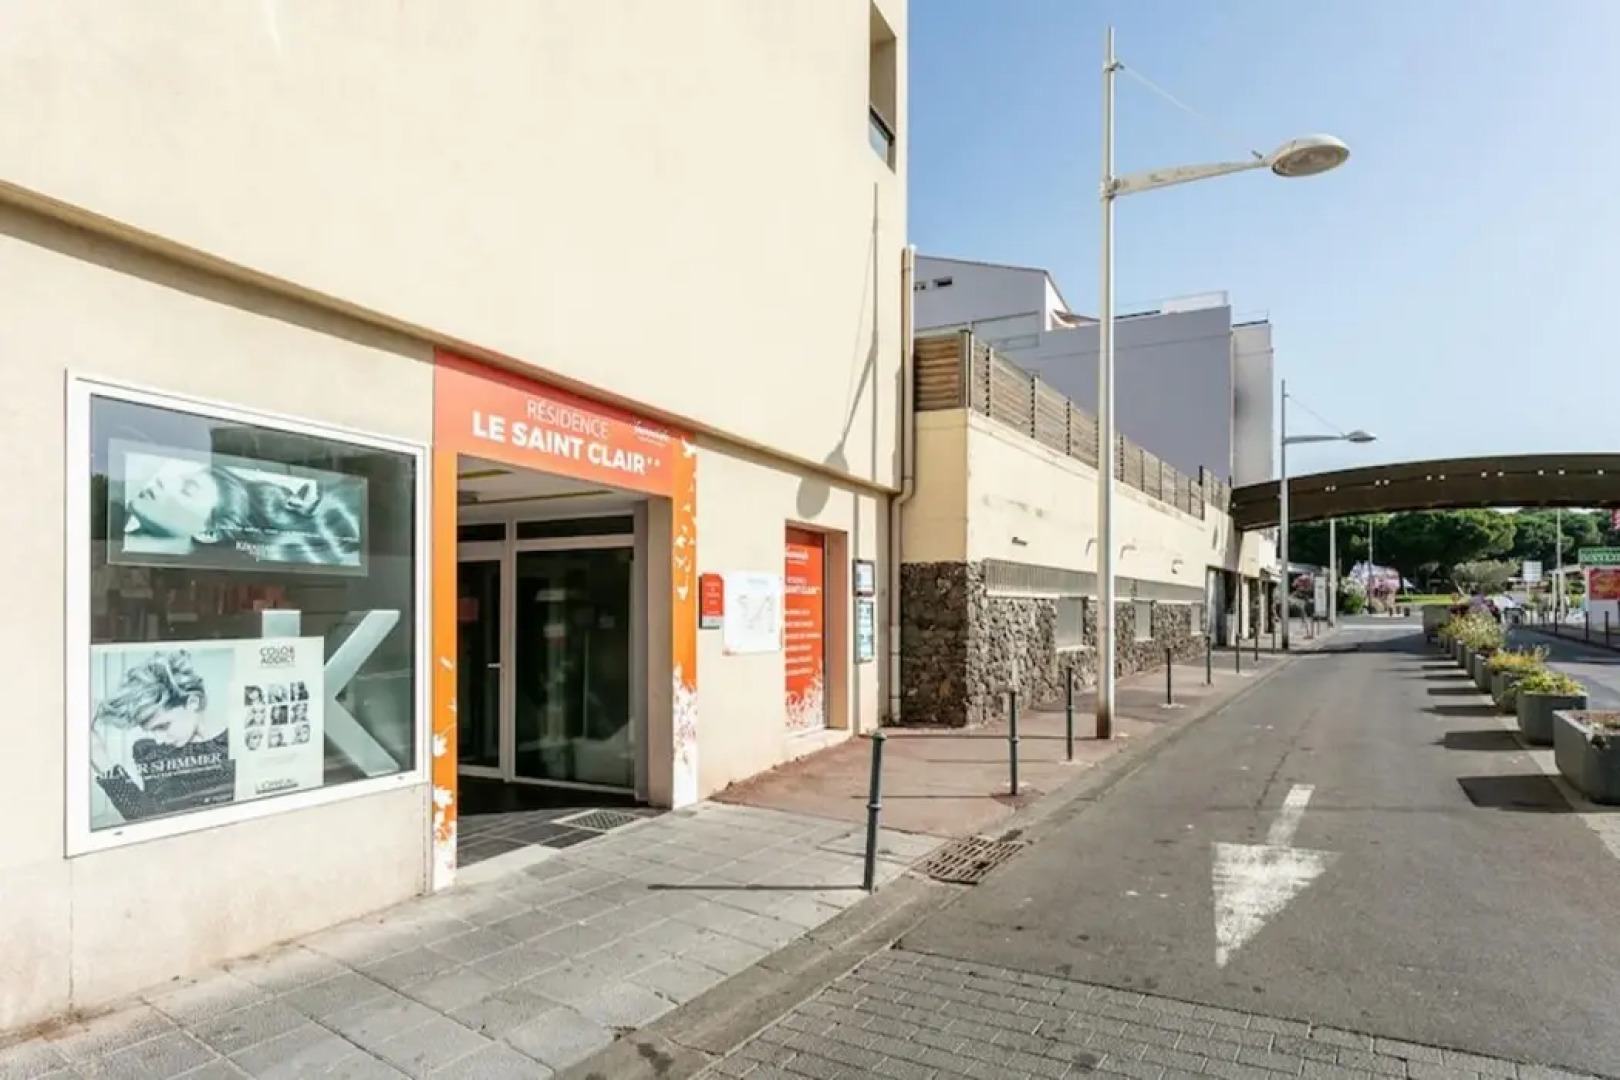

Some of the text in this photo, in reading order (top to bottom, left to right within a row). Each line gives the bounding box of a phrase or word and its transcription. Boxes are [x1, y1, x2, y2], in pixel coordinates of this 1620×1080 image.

[526, 399, 611, 439] RÉSIDENCE
[472, 411, 507, 443] LE
[511, 420, 584, 461] SAINT
[259, 645, 295, 656] COLOR
[150, 752, 222, 773] SHIMMER
